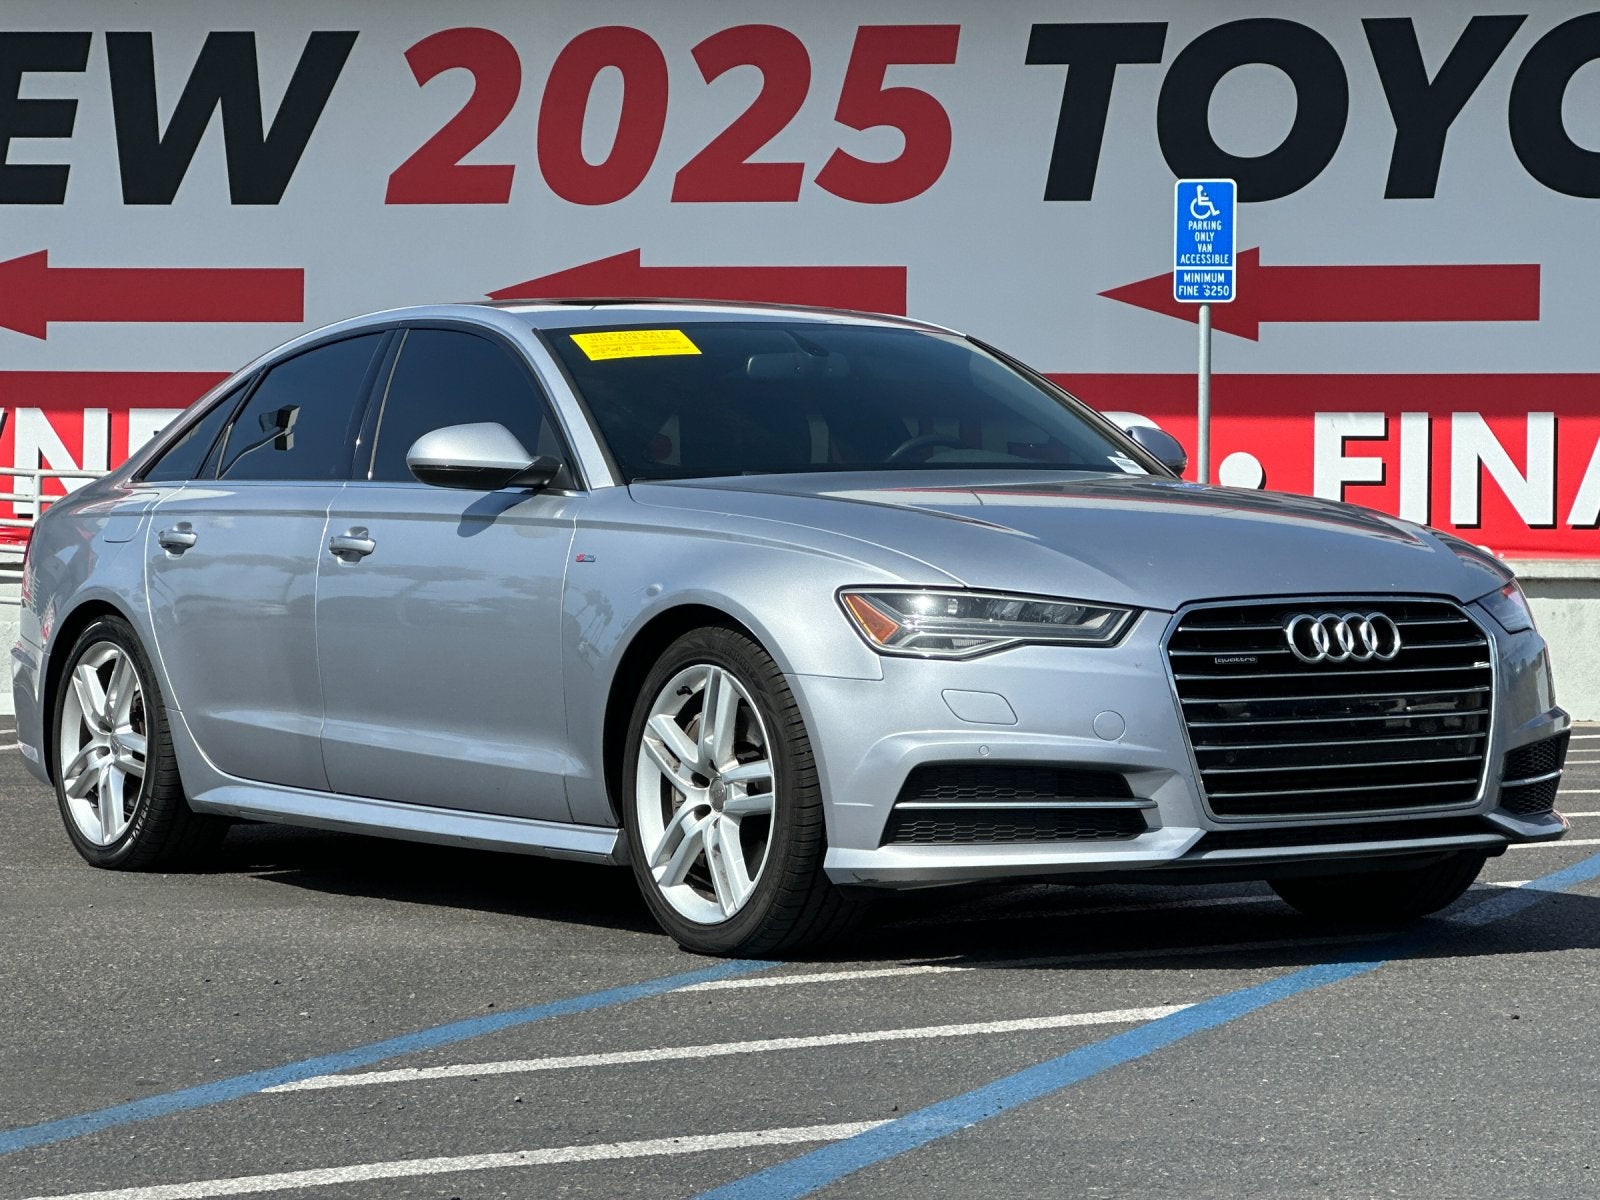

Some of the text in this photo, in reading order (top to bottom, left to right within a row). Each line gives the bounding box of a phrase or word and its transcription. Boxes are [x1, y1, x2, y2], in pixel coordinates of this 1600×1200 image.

[385, 25, 959, 205] 2025
[1188, 220, 1222, 231] PARKING
[1194, 231, 1215, 242] ONLY
[1197, 243, 1212, 253] VAN
[1180, 254, 1229, 265] ACCESSIBLE
[1183, 272, 1225, 283] MINIMUM
[1178, 285, 1230, 297] FINE $250
